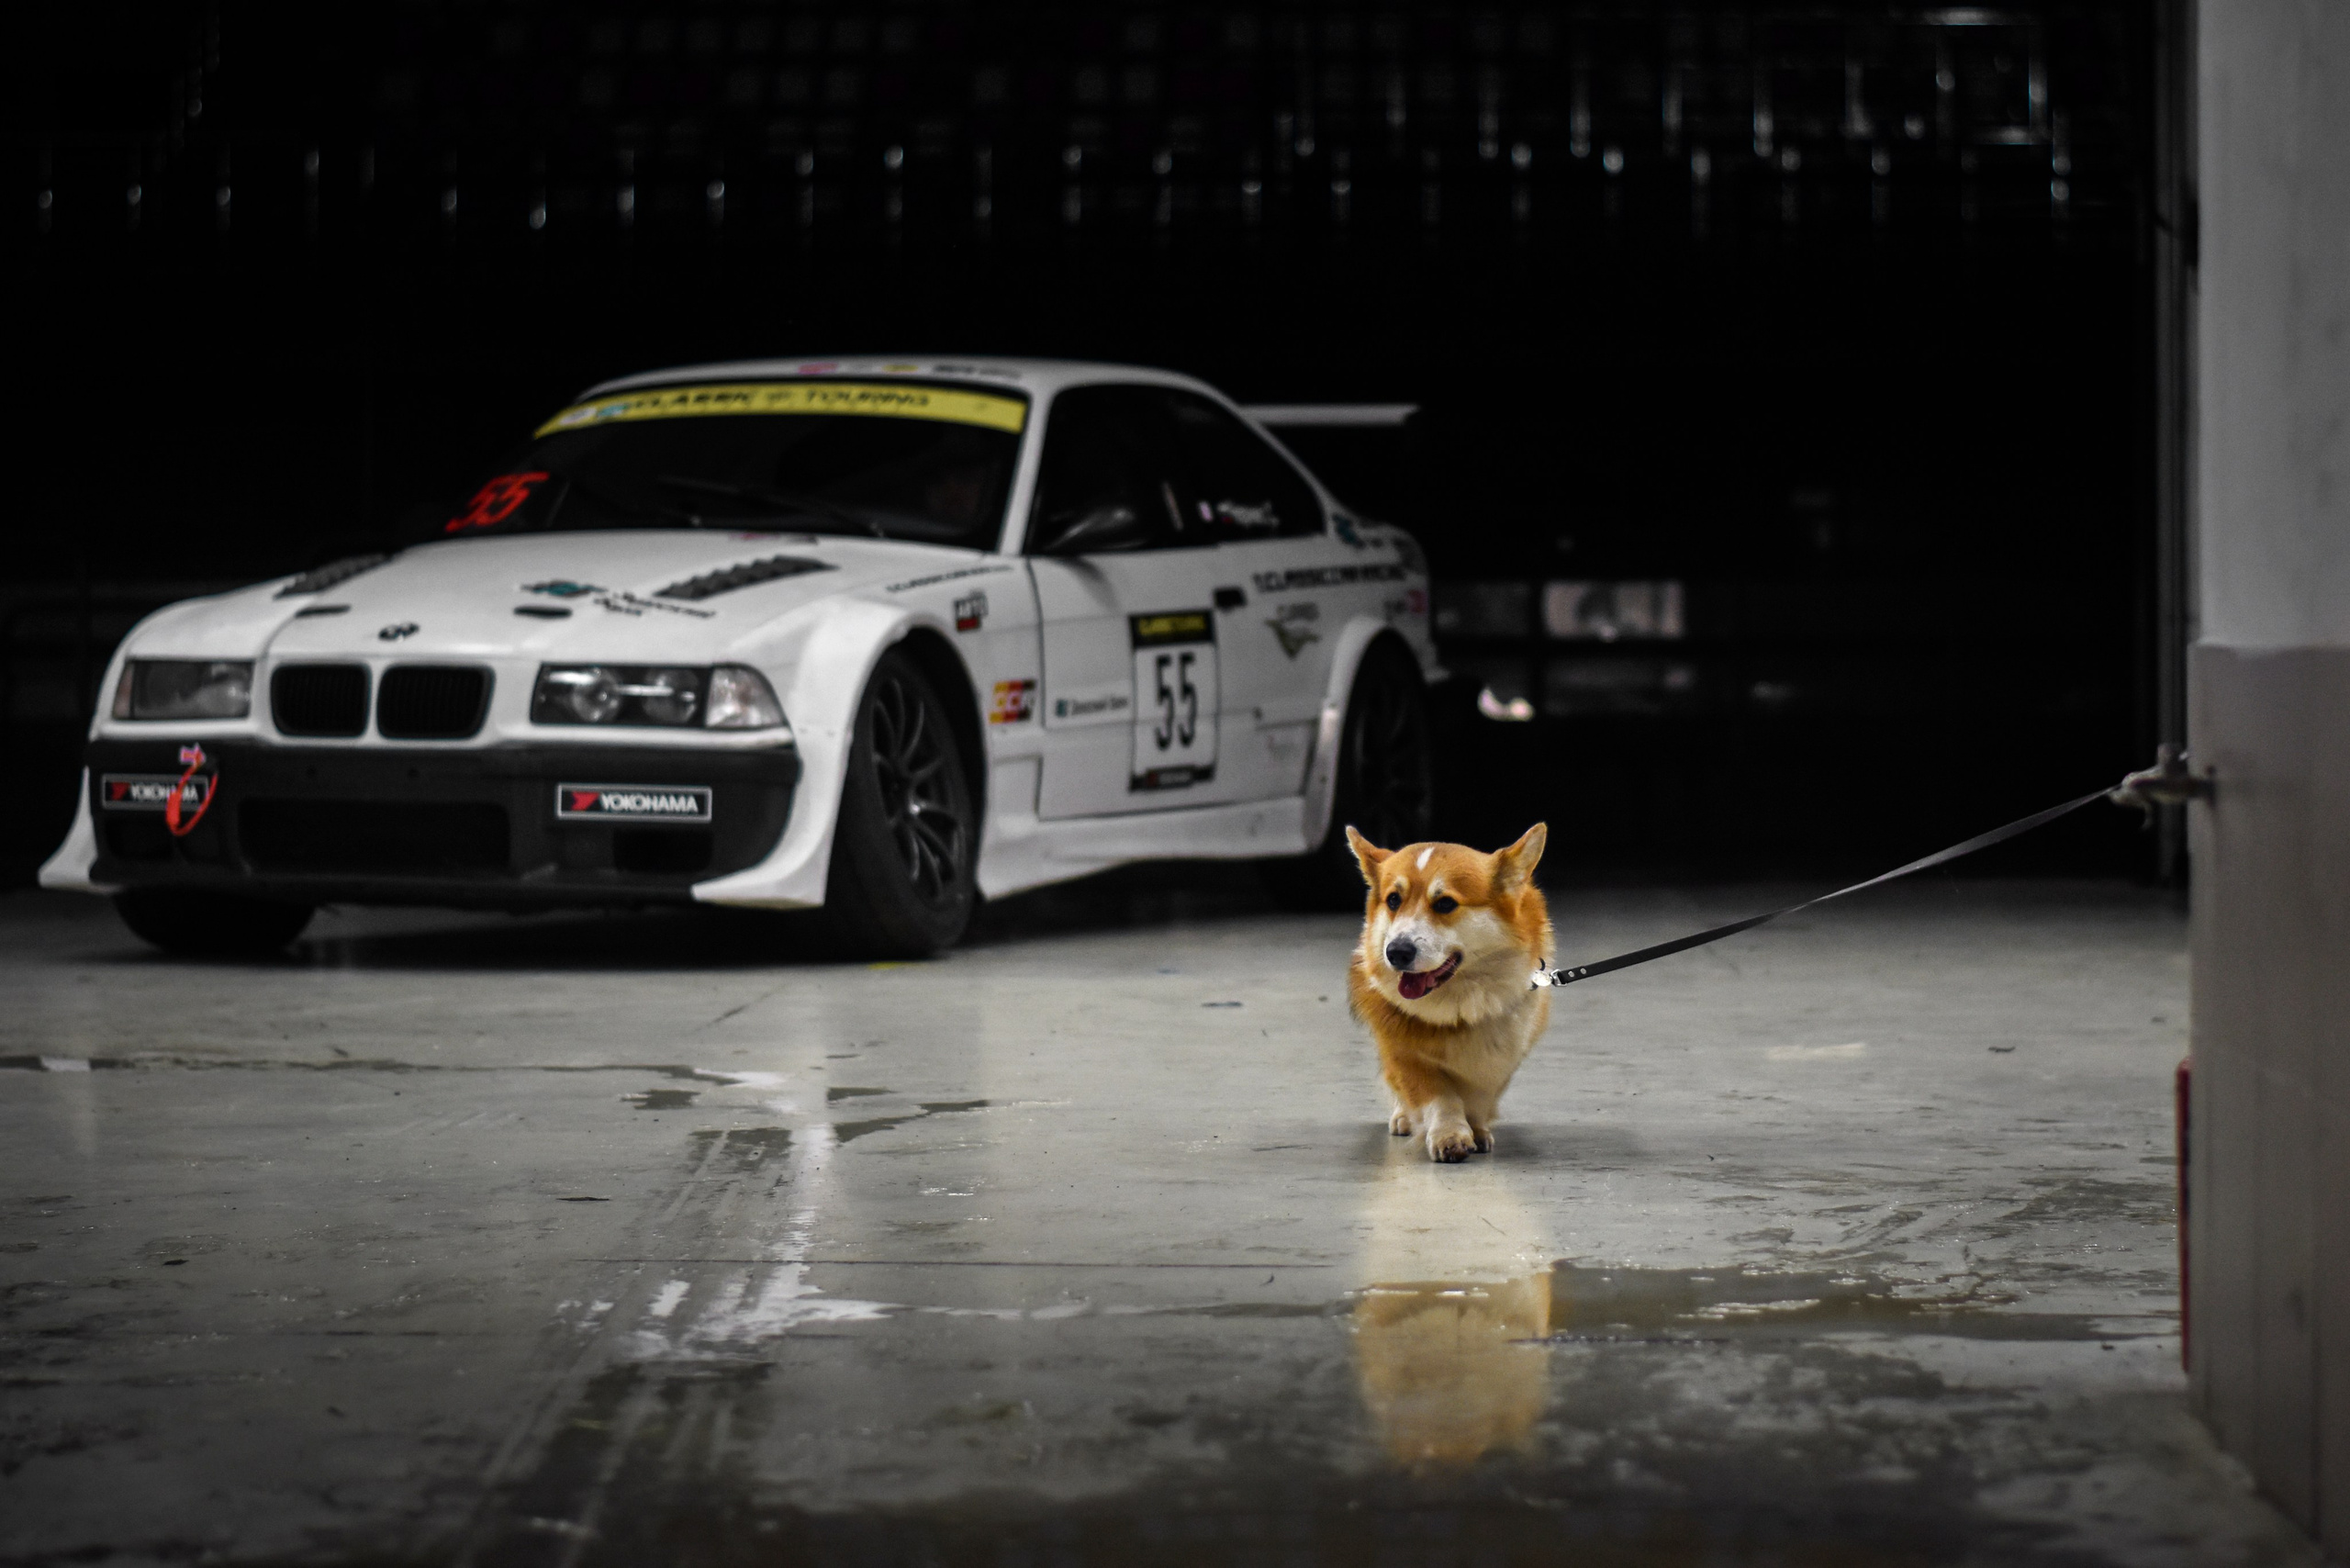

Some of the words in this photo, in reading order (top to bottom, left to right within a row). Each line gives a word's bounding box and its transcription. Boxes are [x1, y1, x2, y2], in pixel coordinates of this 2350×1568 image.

[445, 471, 550, 533] 55
[1155, 651, 1199, 752] 55
[129, 782, 200, 801] YOKOHMA
[599, 791, 699, 813] YOKOHAMA
